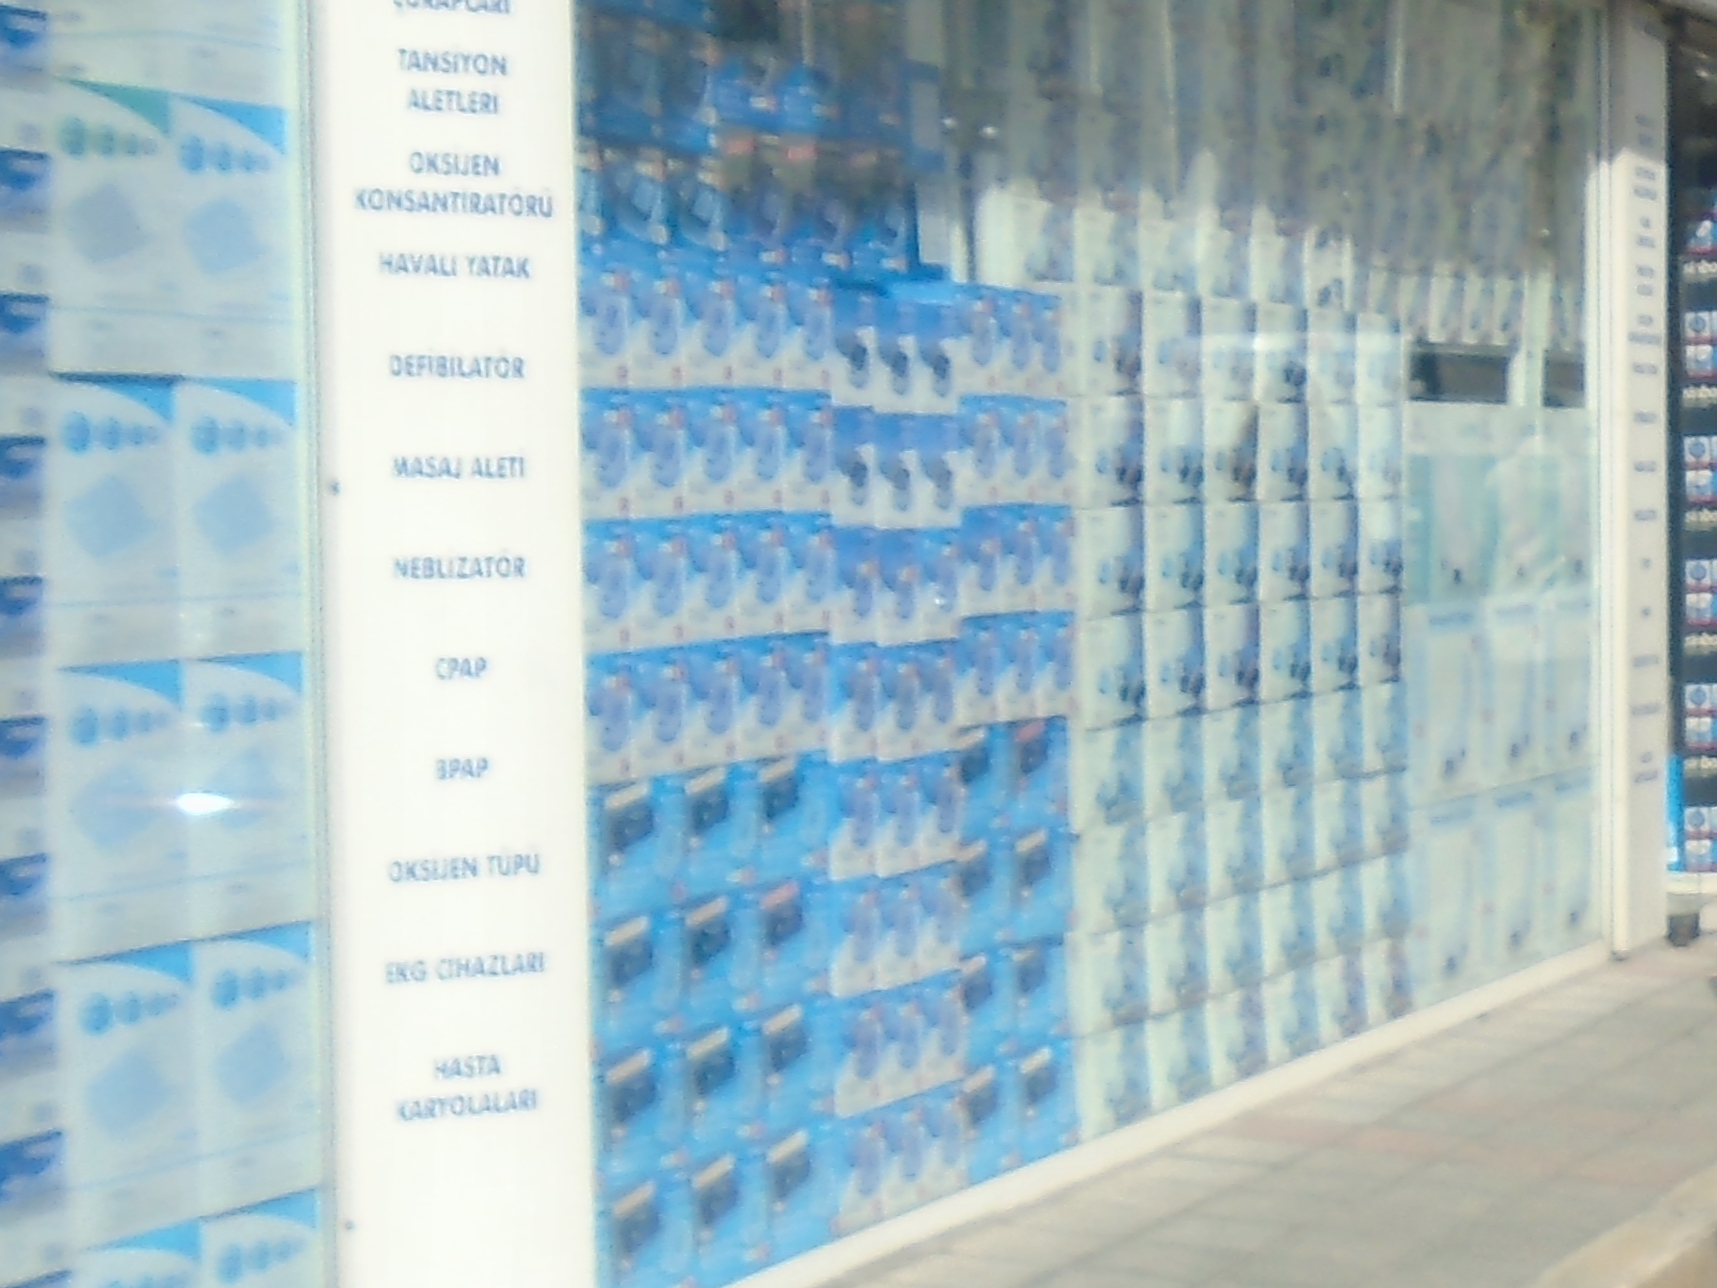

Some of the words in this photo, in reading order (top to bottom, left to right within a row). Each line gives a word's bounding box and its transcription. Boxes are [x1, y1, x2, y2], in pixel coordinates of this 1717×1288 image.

[379, 251, 459, 278] HAVALI
[466, 254, 532, 280] YATAK
[392, 455, 464, 480] MASAJ
[433, 1053, 503, 1079] HASTA
